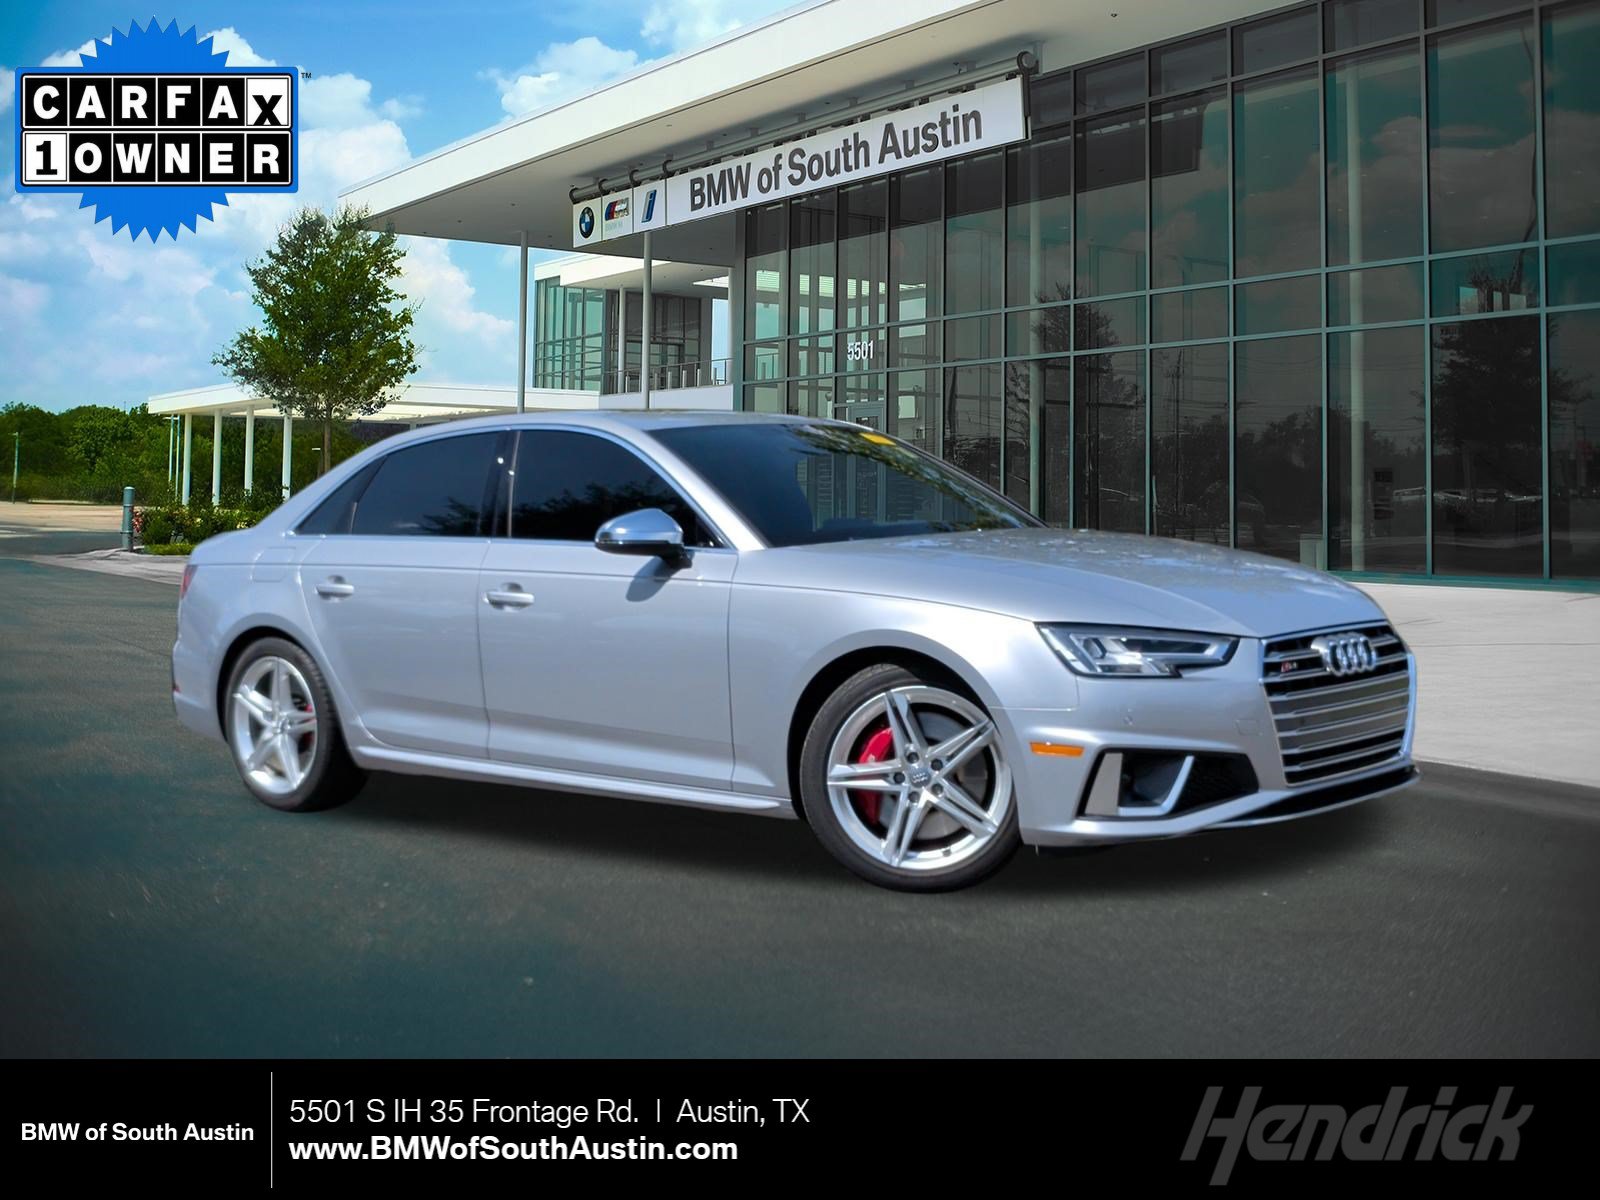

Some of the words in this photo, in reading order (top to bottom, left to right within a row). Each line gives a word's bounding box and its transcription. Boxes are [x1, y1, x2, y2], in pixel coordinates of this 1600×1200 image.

[689, 162, 752, 212] BMW
[757, 153, 782, 194] of
[787, 132, 870, 186] South
[878, 103, 983, 165] Austin
[847, 340, 874, 361] 5501
